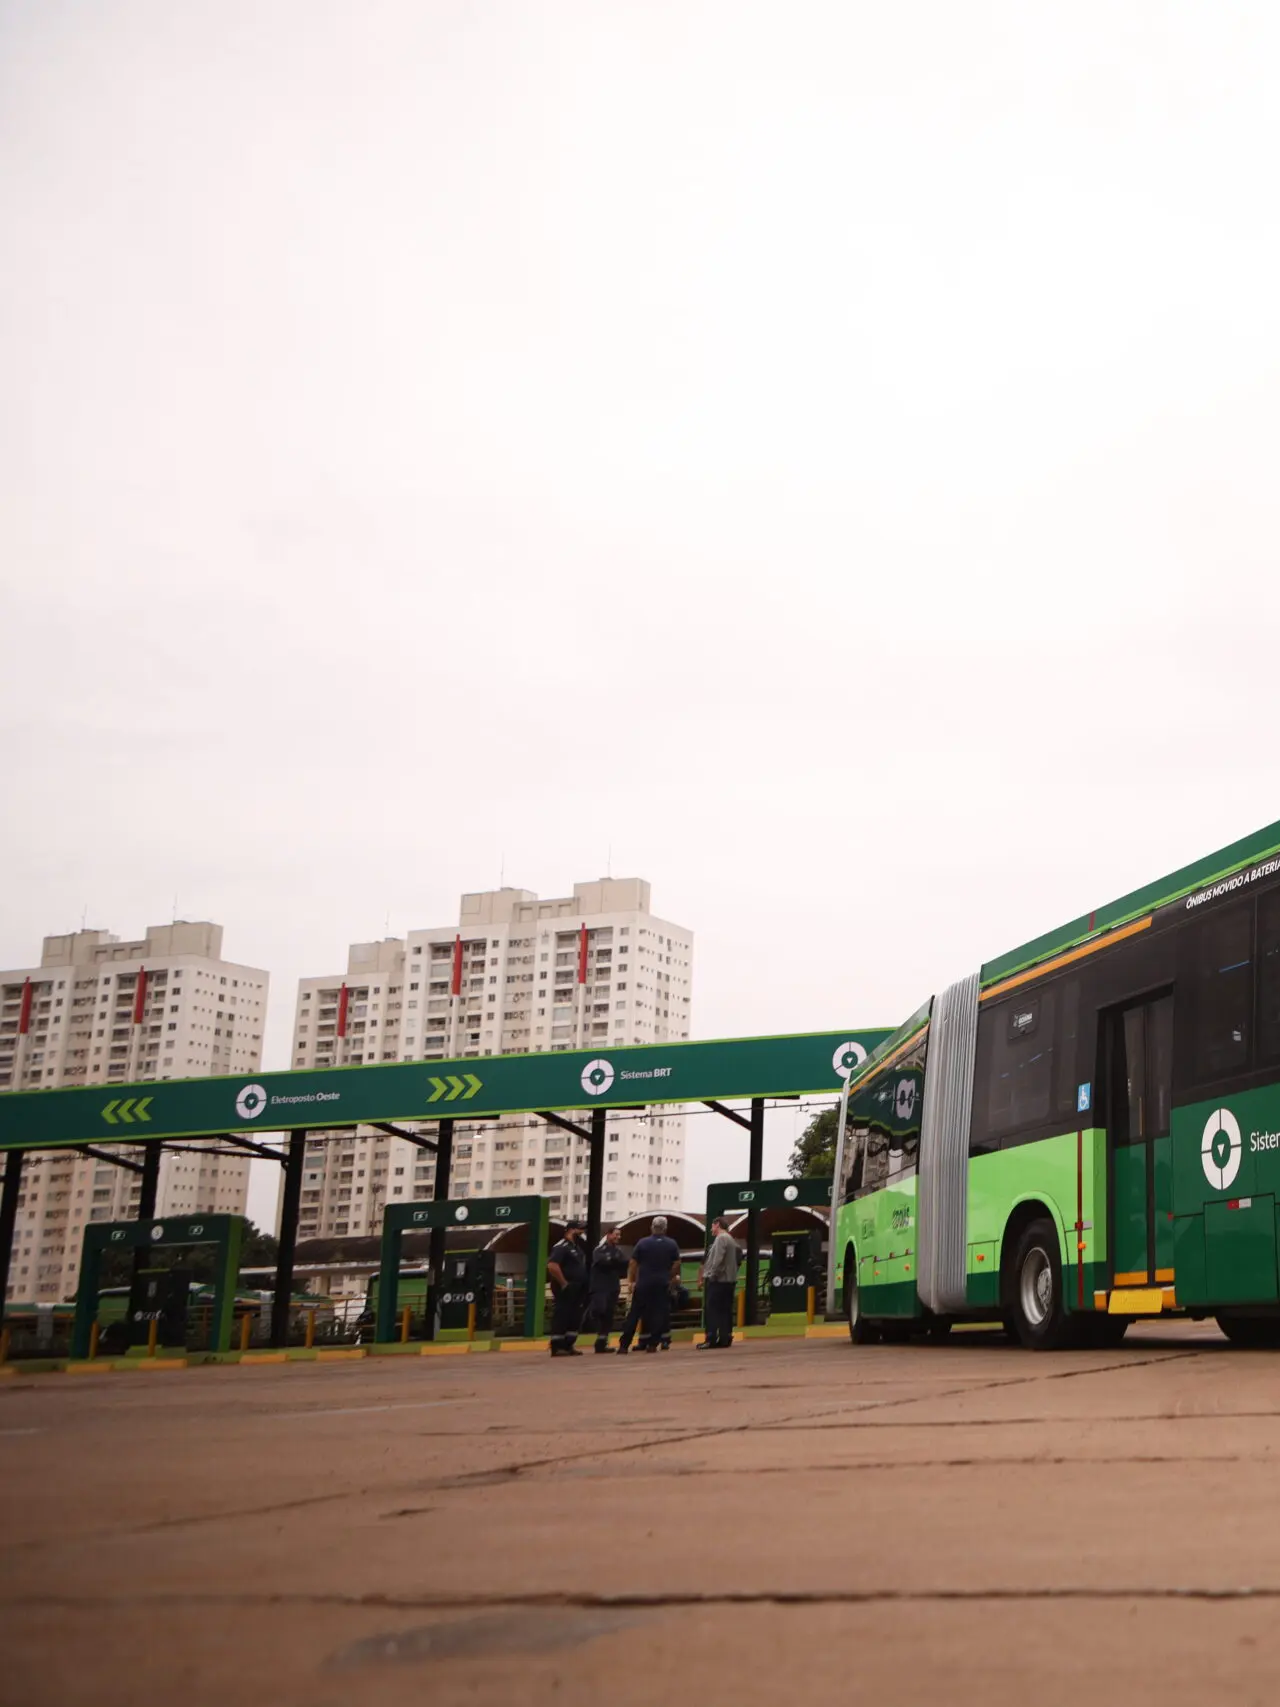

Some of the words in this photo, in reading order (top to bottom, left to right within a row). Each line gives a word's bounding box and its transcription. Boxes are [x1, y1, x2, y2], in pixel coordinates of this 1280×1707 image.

[1185, 887, 1213, 910] ÔNIBUS
[1212, 875, 1244, 897] MOVIDO
[1243, 874, 1250, 883] A
[620, 1070, 653, 1080] Sistema
[653, 1067, 672, 1078] BRT
[271, 1094, 316, 1105] Eletroposto
[316, 1092, 341, 1102] Oeste
